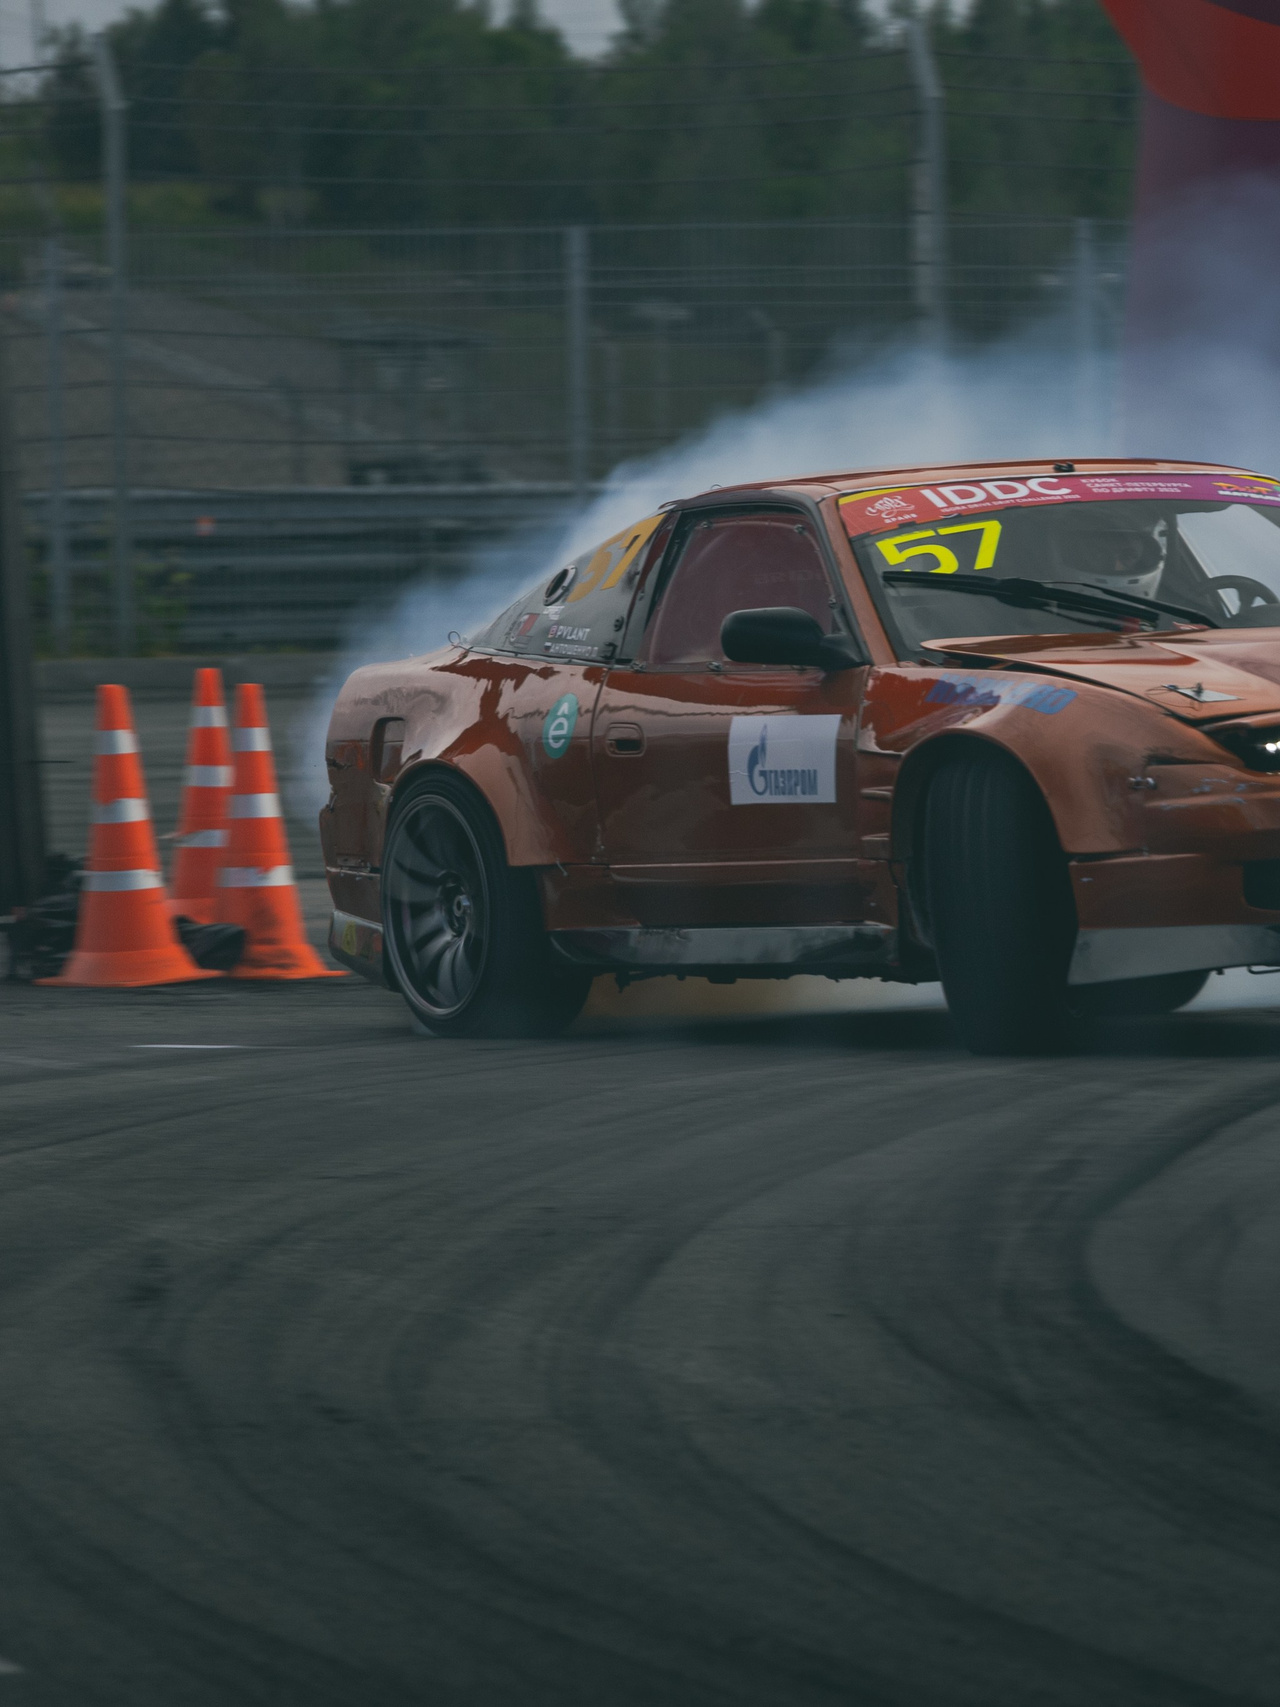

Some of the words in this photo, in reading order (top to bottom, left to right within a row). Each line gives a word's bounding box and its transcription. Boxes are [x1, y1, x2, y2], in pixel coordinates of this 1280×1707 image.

[920, 478, 1073, 508] IDDC
[566, 512, 667, 603] 57
[875, 520, 1002, 574] 57
